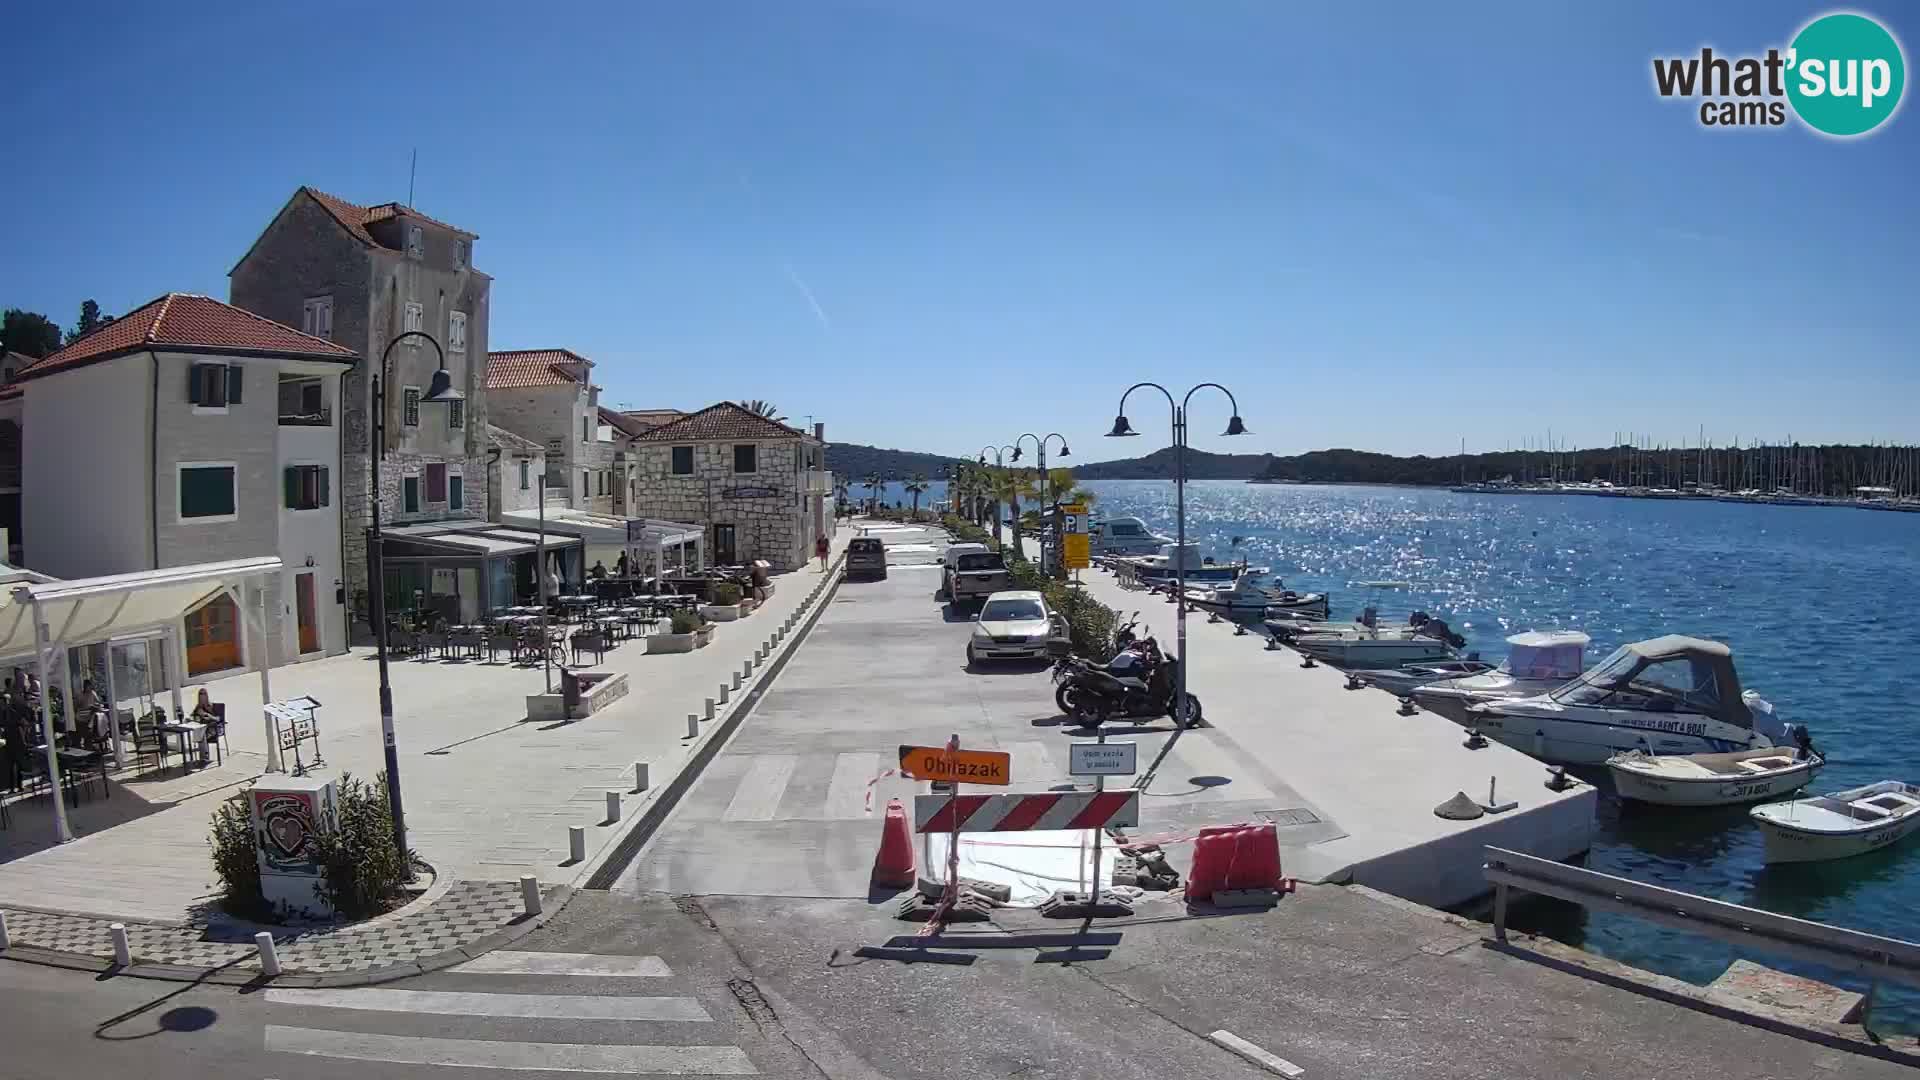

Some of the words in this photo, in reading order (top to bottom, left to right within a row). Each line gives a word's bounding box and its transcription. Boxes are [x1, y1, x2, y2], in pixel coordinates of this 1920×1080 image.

[1657, 720, 1679, 731] RENT
[1687, 722, 1706, 736] BOAT
[924, 756, 1000, 777] Obilazak
